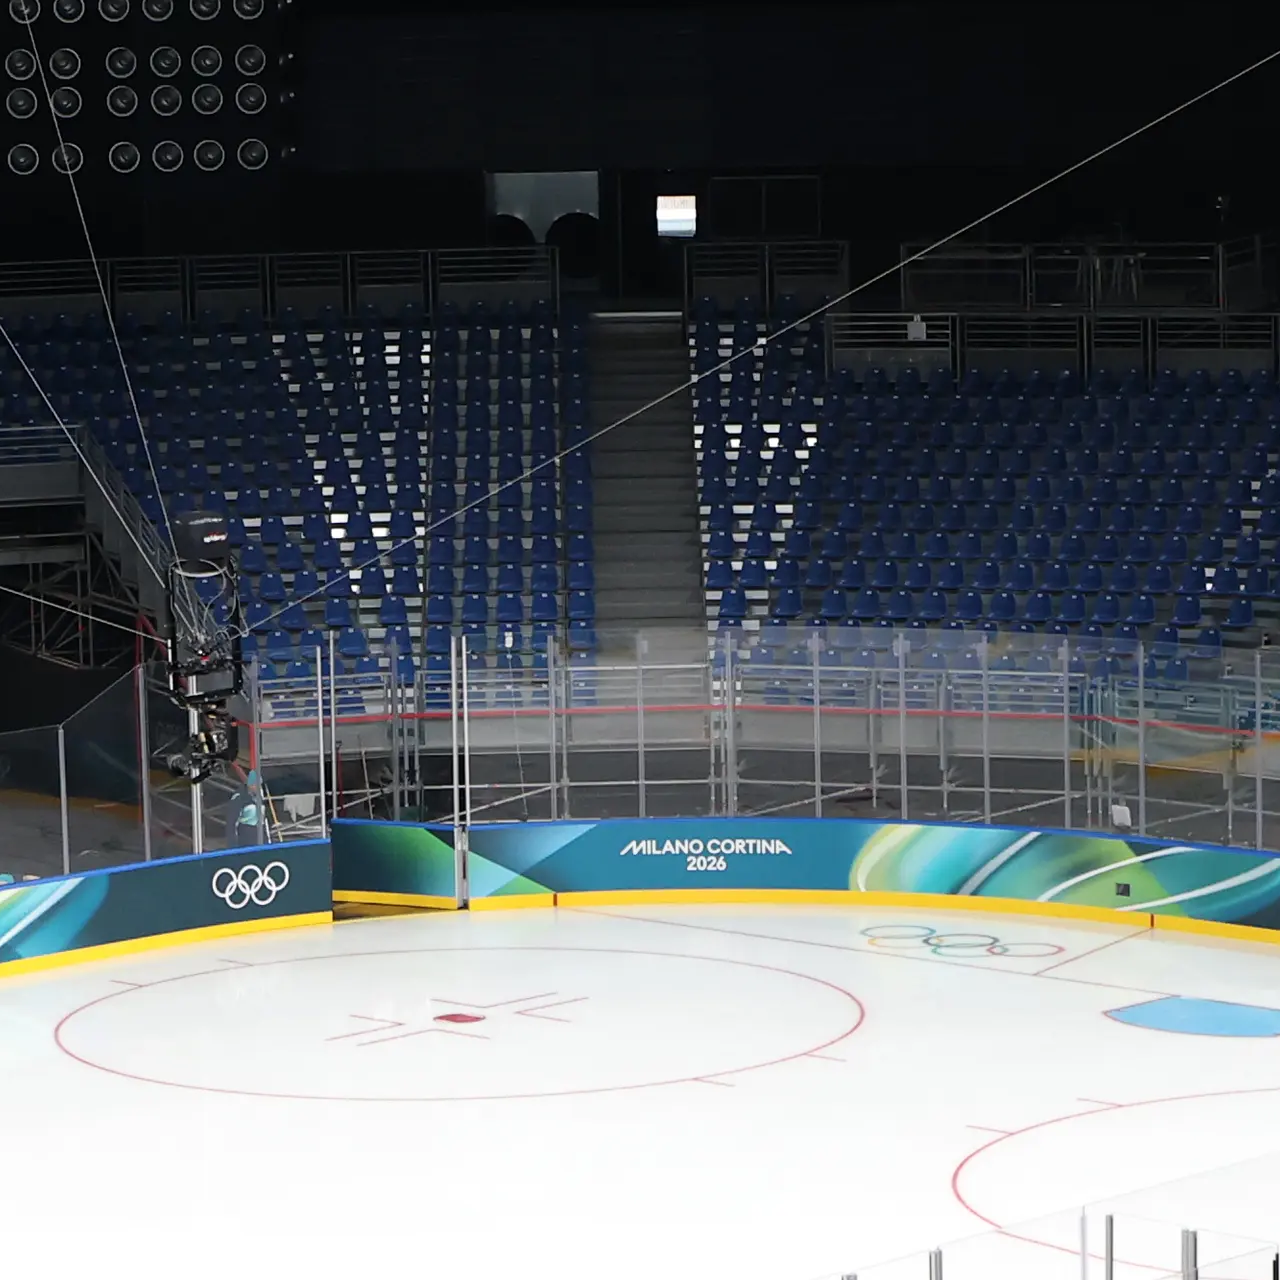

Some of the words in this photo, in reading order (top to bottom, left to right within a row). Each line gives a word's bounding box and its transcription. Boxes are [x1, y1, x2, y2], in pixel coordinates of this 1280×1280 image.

[619, 838, 704, 856] MILANO
[707, 838, 793, 855] CORTINA
[686, 855, 728, 871] 2026
